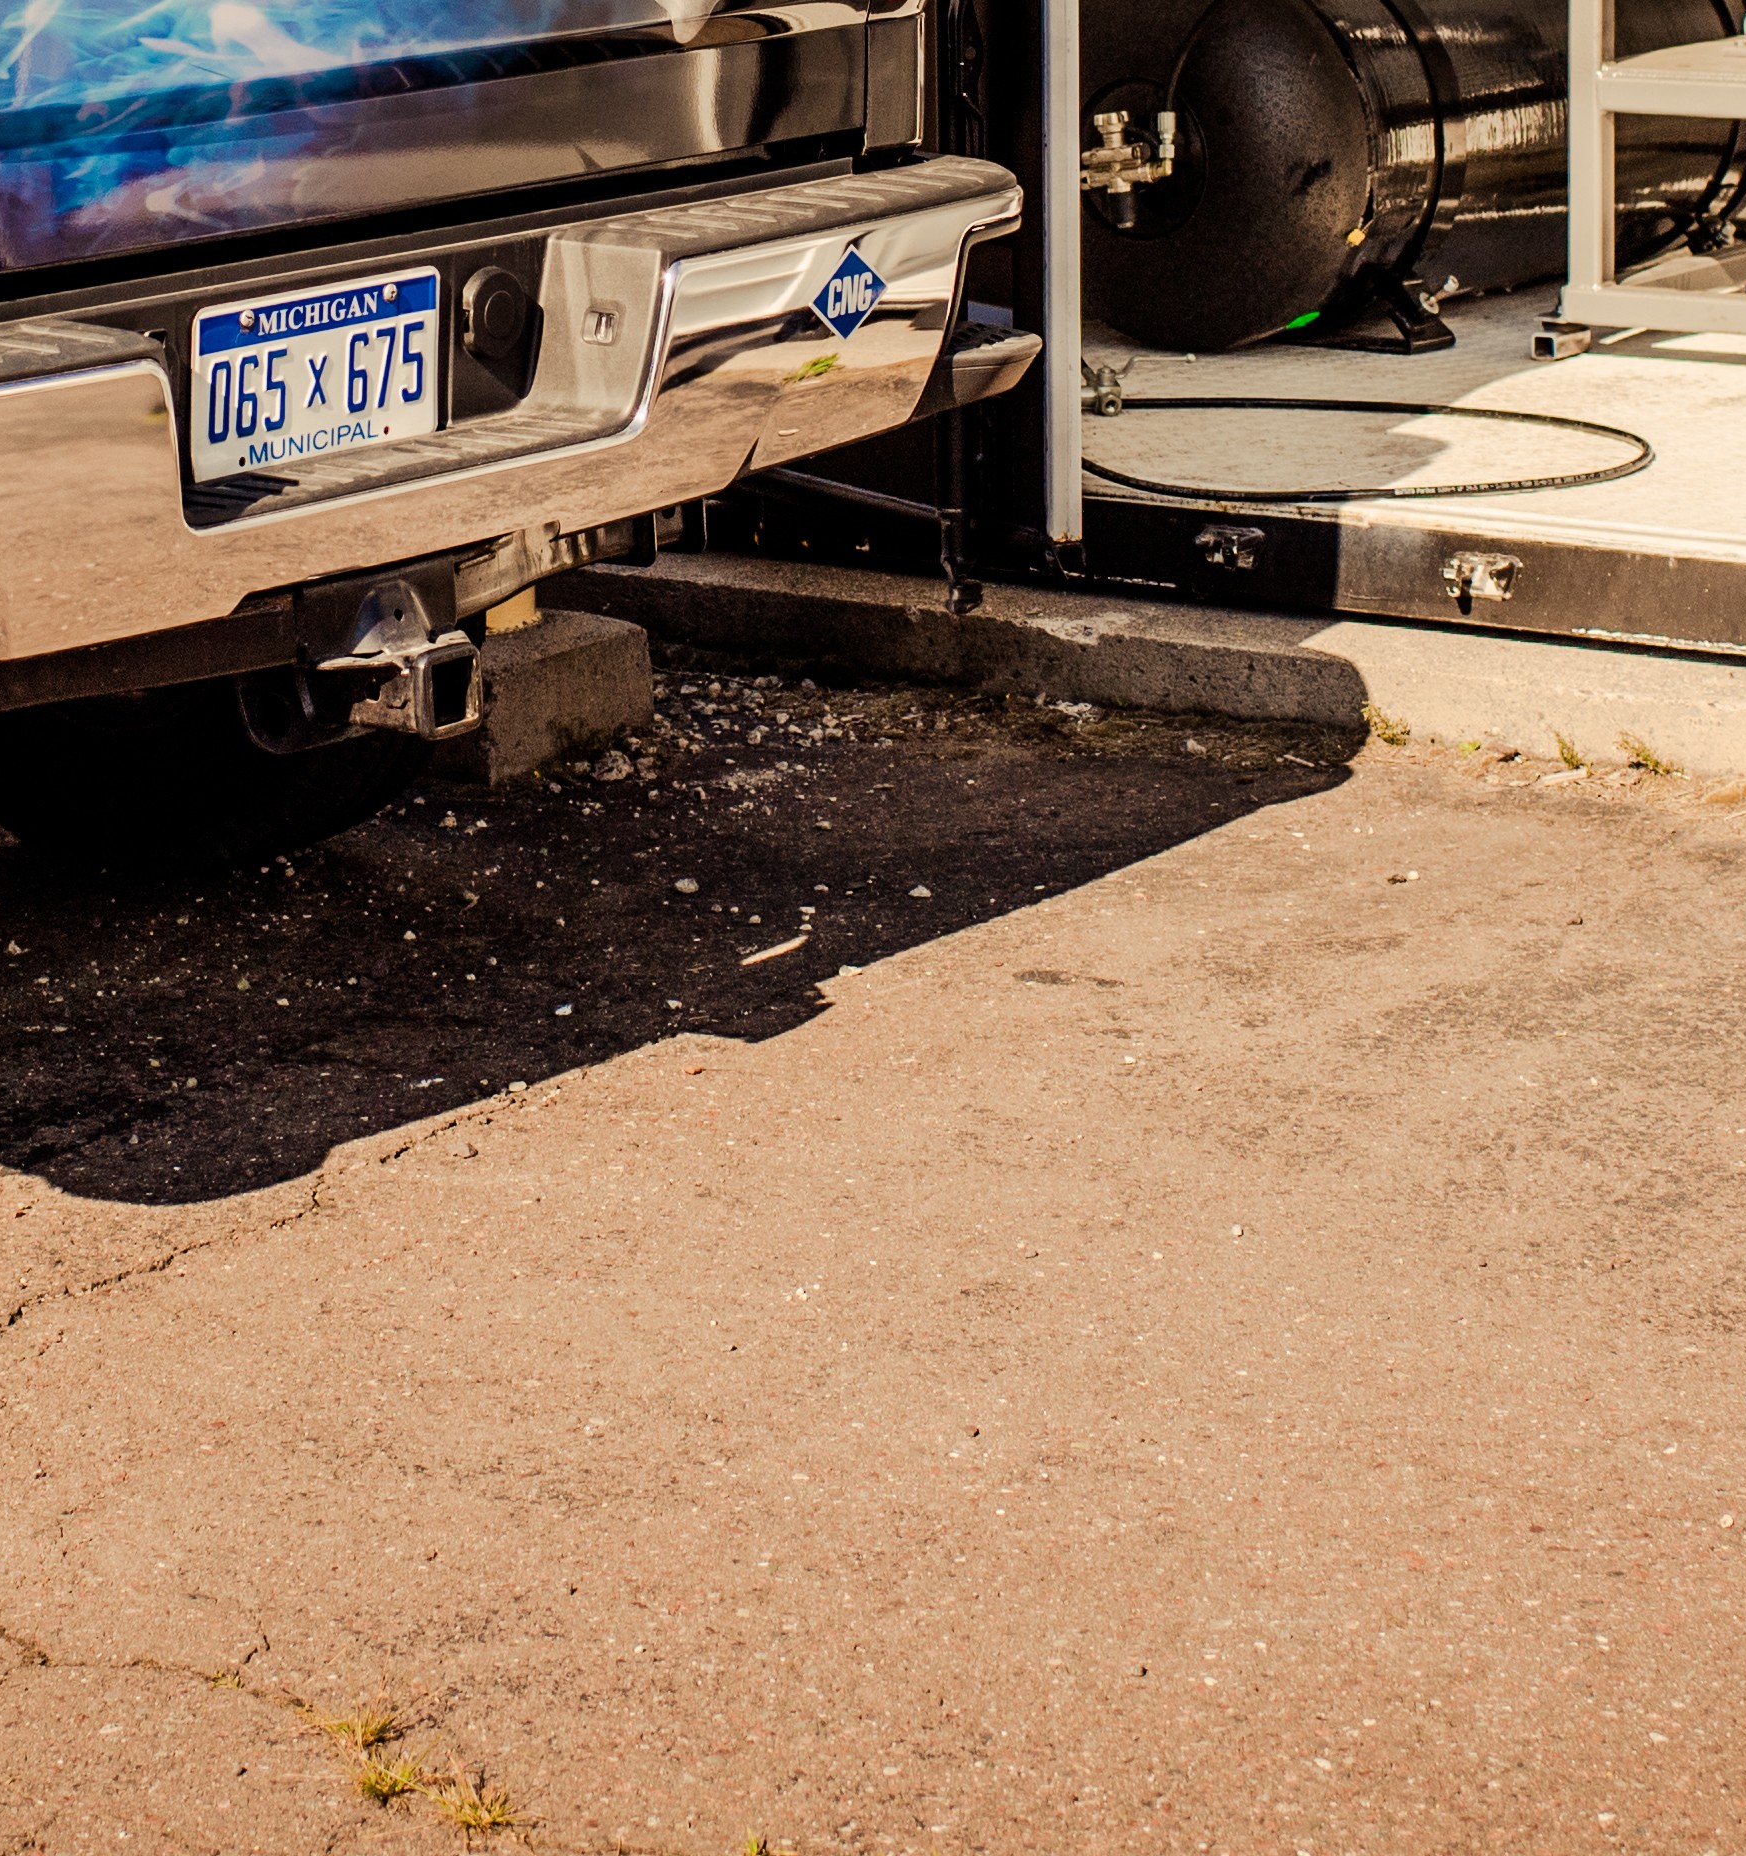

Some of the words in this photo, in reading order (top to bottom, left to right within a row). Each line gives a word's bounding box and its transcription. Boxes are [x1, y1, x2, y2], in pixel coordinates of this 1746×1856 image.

[257, 292, 379, 337] MICHIGAN
[827, 271, 873, 319] CNG
[207, 347, 289, 444] 065
[346, 319, 425, 414] 675
[248, 420, 379, 465] MUNICIPAL
